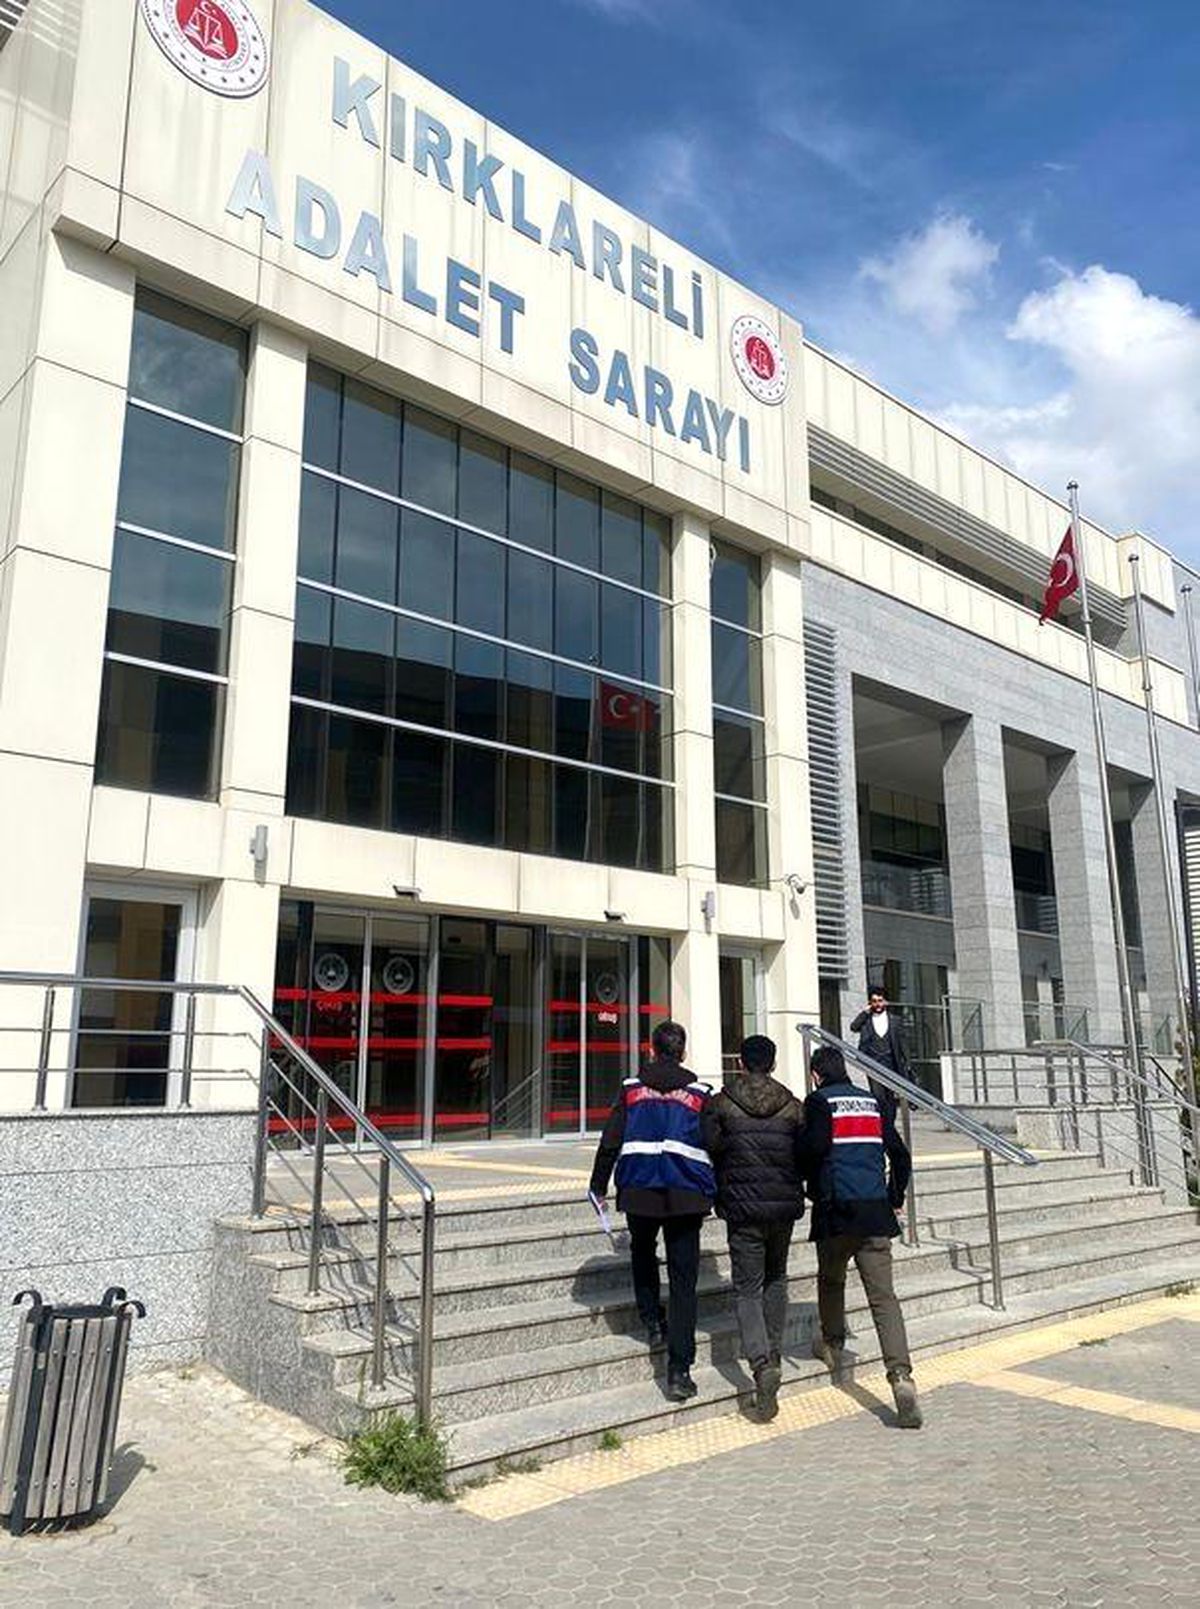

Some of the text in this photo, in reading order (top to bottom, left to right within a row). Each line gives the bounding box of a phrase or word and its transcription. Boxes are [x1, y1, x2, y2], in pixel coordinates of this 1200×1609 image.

[225, 147, 750, 474] ADALET SARAYI
[332, 55, 704, 339] KIRKLARELİ
